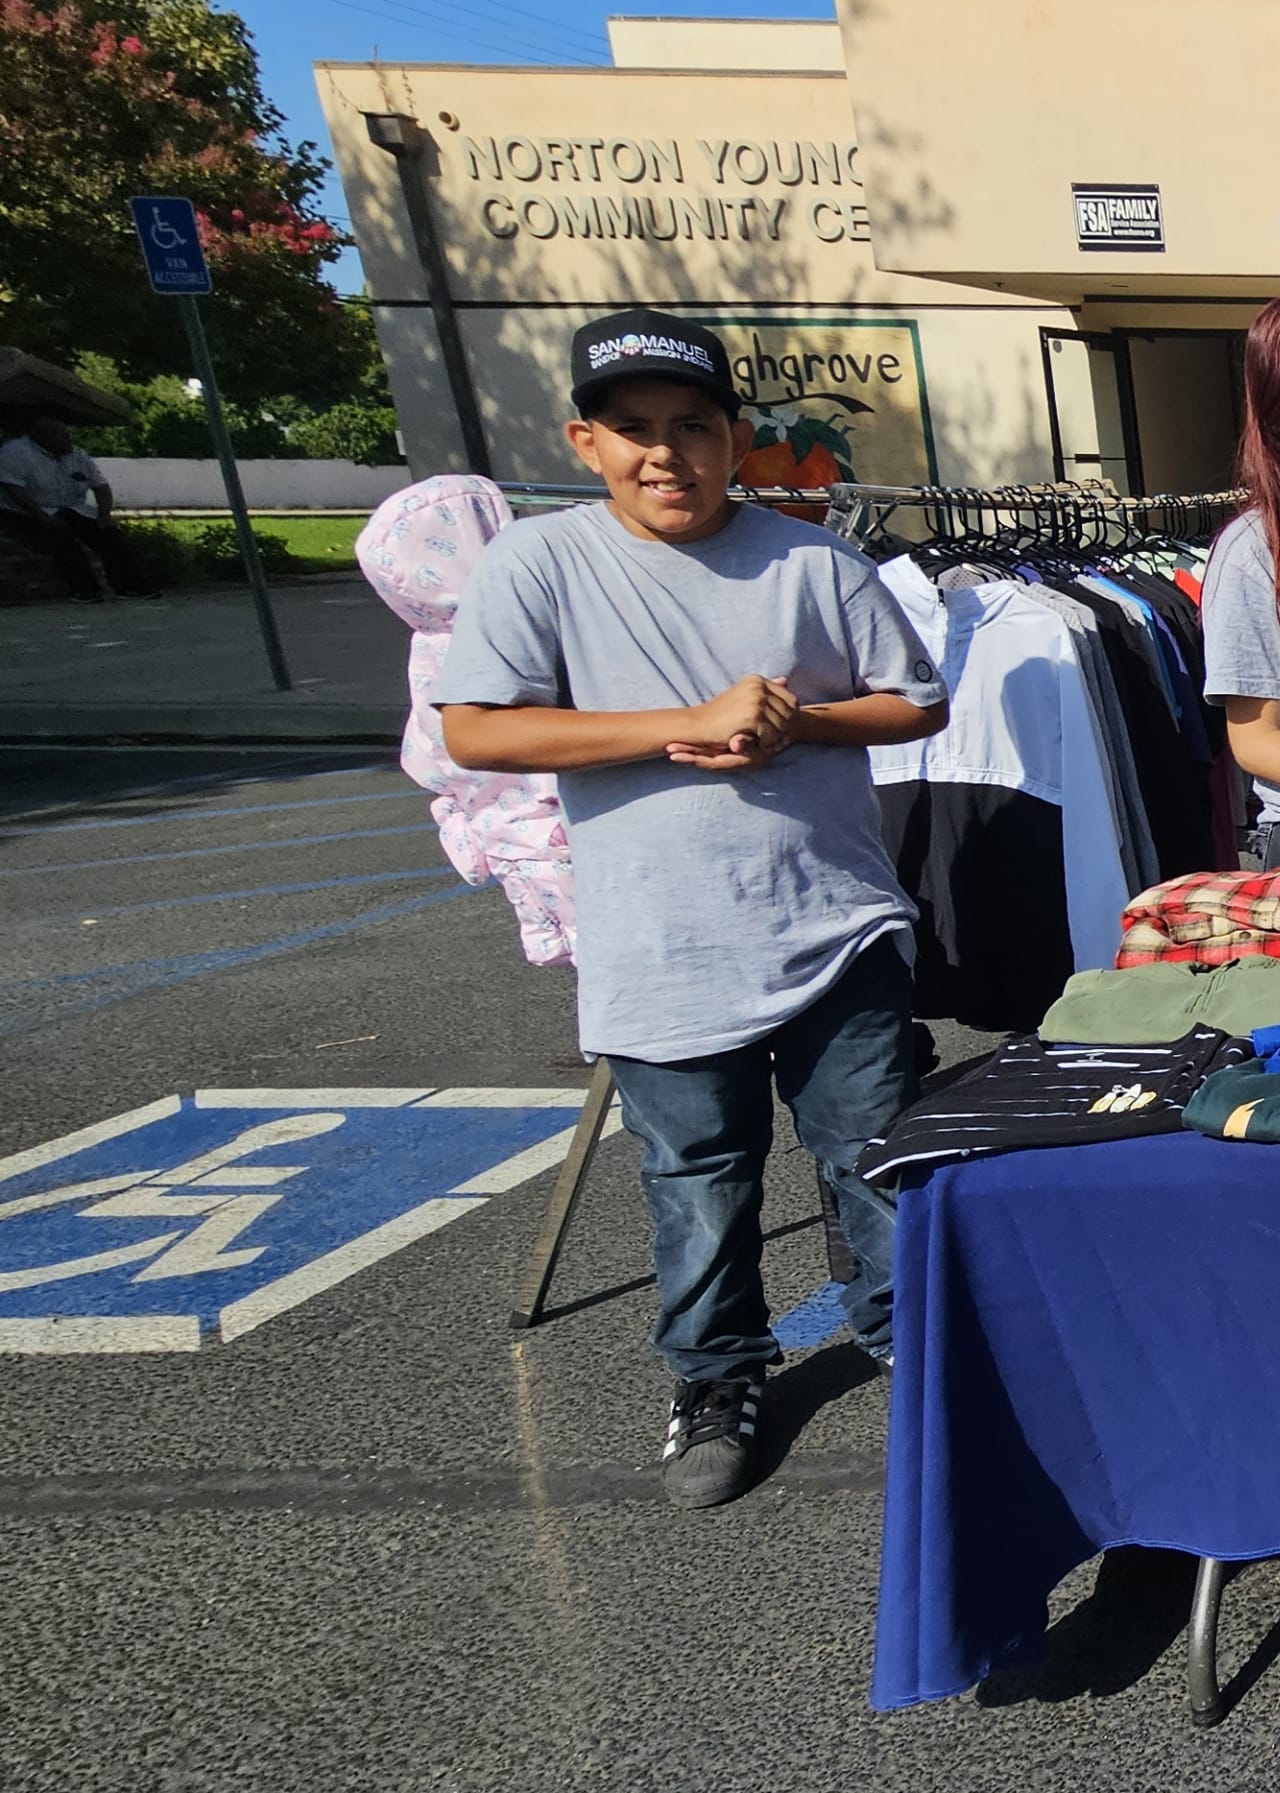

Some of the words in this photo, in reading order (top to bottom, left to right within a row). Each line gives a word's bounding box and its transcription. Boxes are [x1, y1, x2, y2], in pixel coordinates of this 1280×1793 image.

[460, 135, 684, 184] NORTON
[481, 192, 790, 241] COMMUNITY
[1078, 201, 1109, 232] FSA
[1108, 198, 1157, 219] FAMILY
[588, 338, 621, 360] SAN
[639, 333, 713, 366] MANUEL
